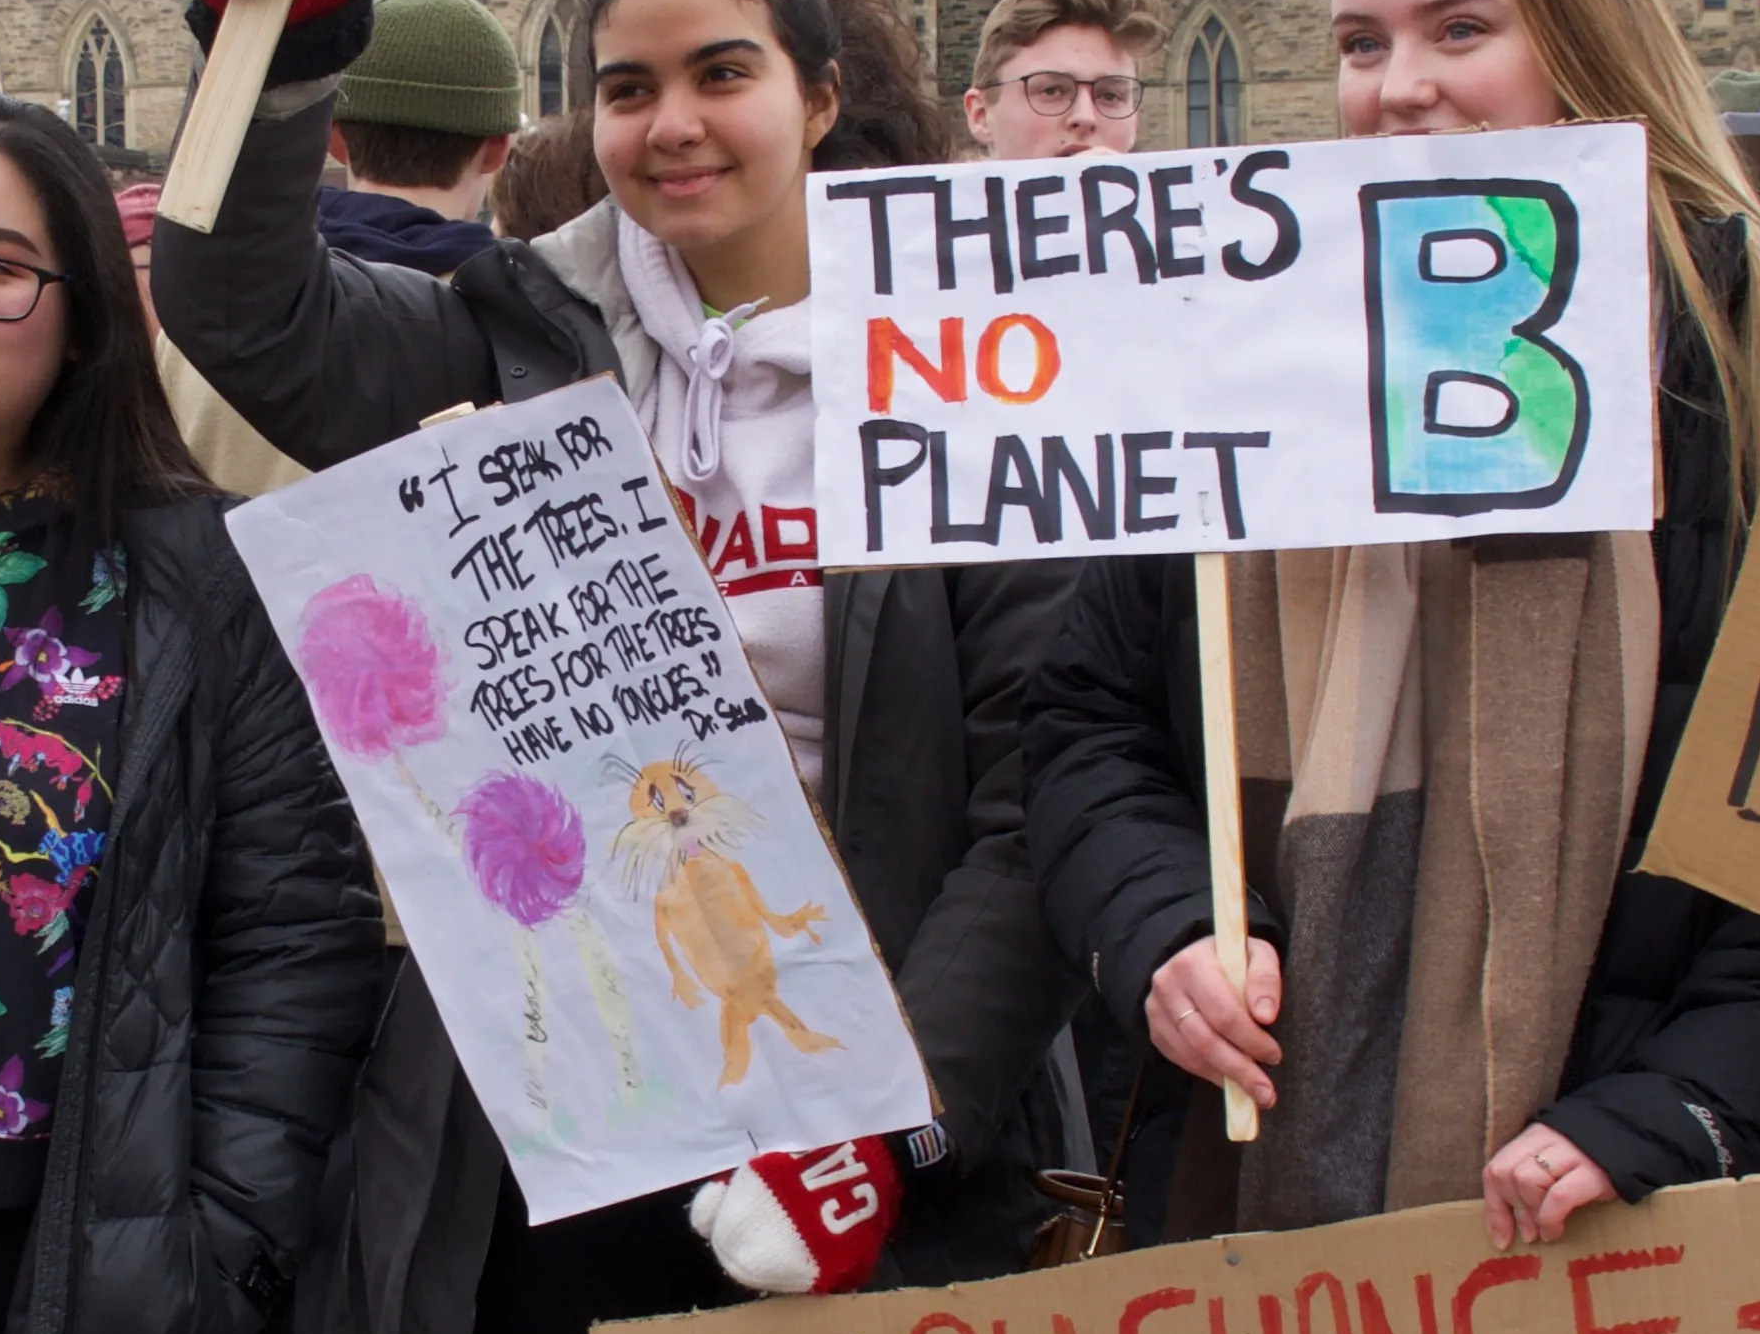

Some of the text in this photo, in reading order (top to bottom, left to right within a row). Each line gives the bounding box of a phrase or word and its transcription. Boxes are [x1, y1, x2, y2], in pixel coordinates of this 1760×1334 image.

[825, 149, 1591, 517] THERE'S B
[866, 313, 1063, 416] NO
[478, 439, 563, 507] SPEAK
[555, 415, 614, 470] FOR
[858, 418, 1271, 553] PLANET
[451, 524, 536, 602] THE
[621, 476, 668, 534] I
[464, 553, 679, 670] SPEAK FOR THE
[469, 606, 722, 731] TREES FOR THE TREES
[503, 716, 573, 766] HAVE
[570, 703, 615, 741] NO
